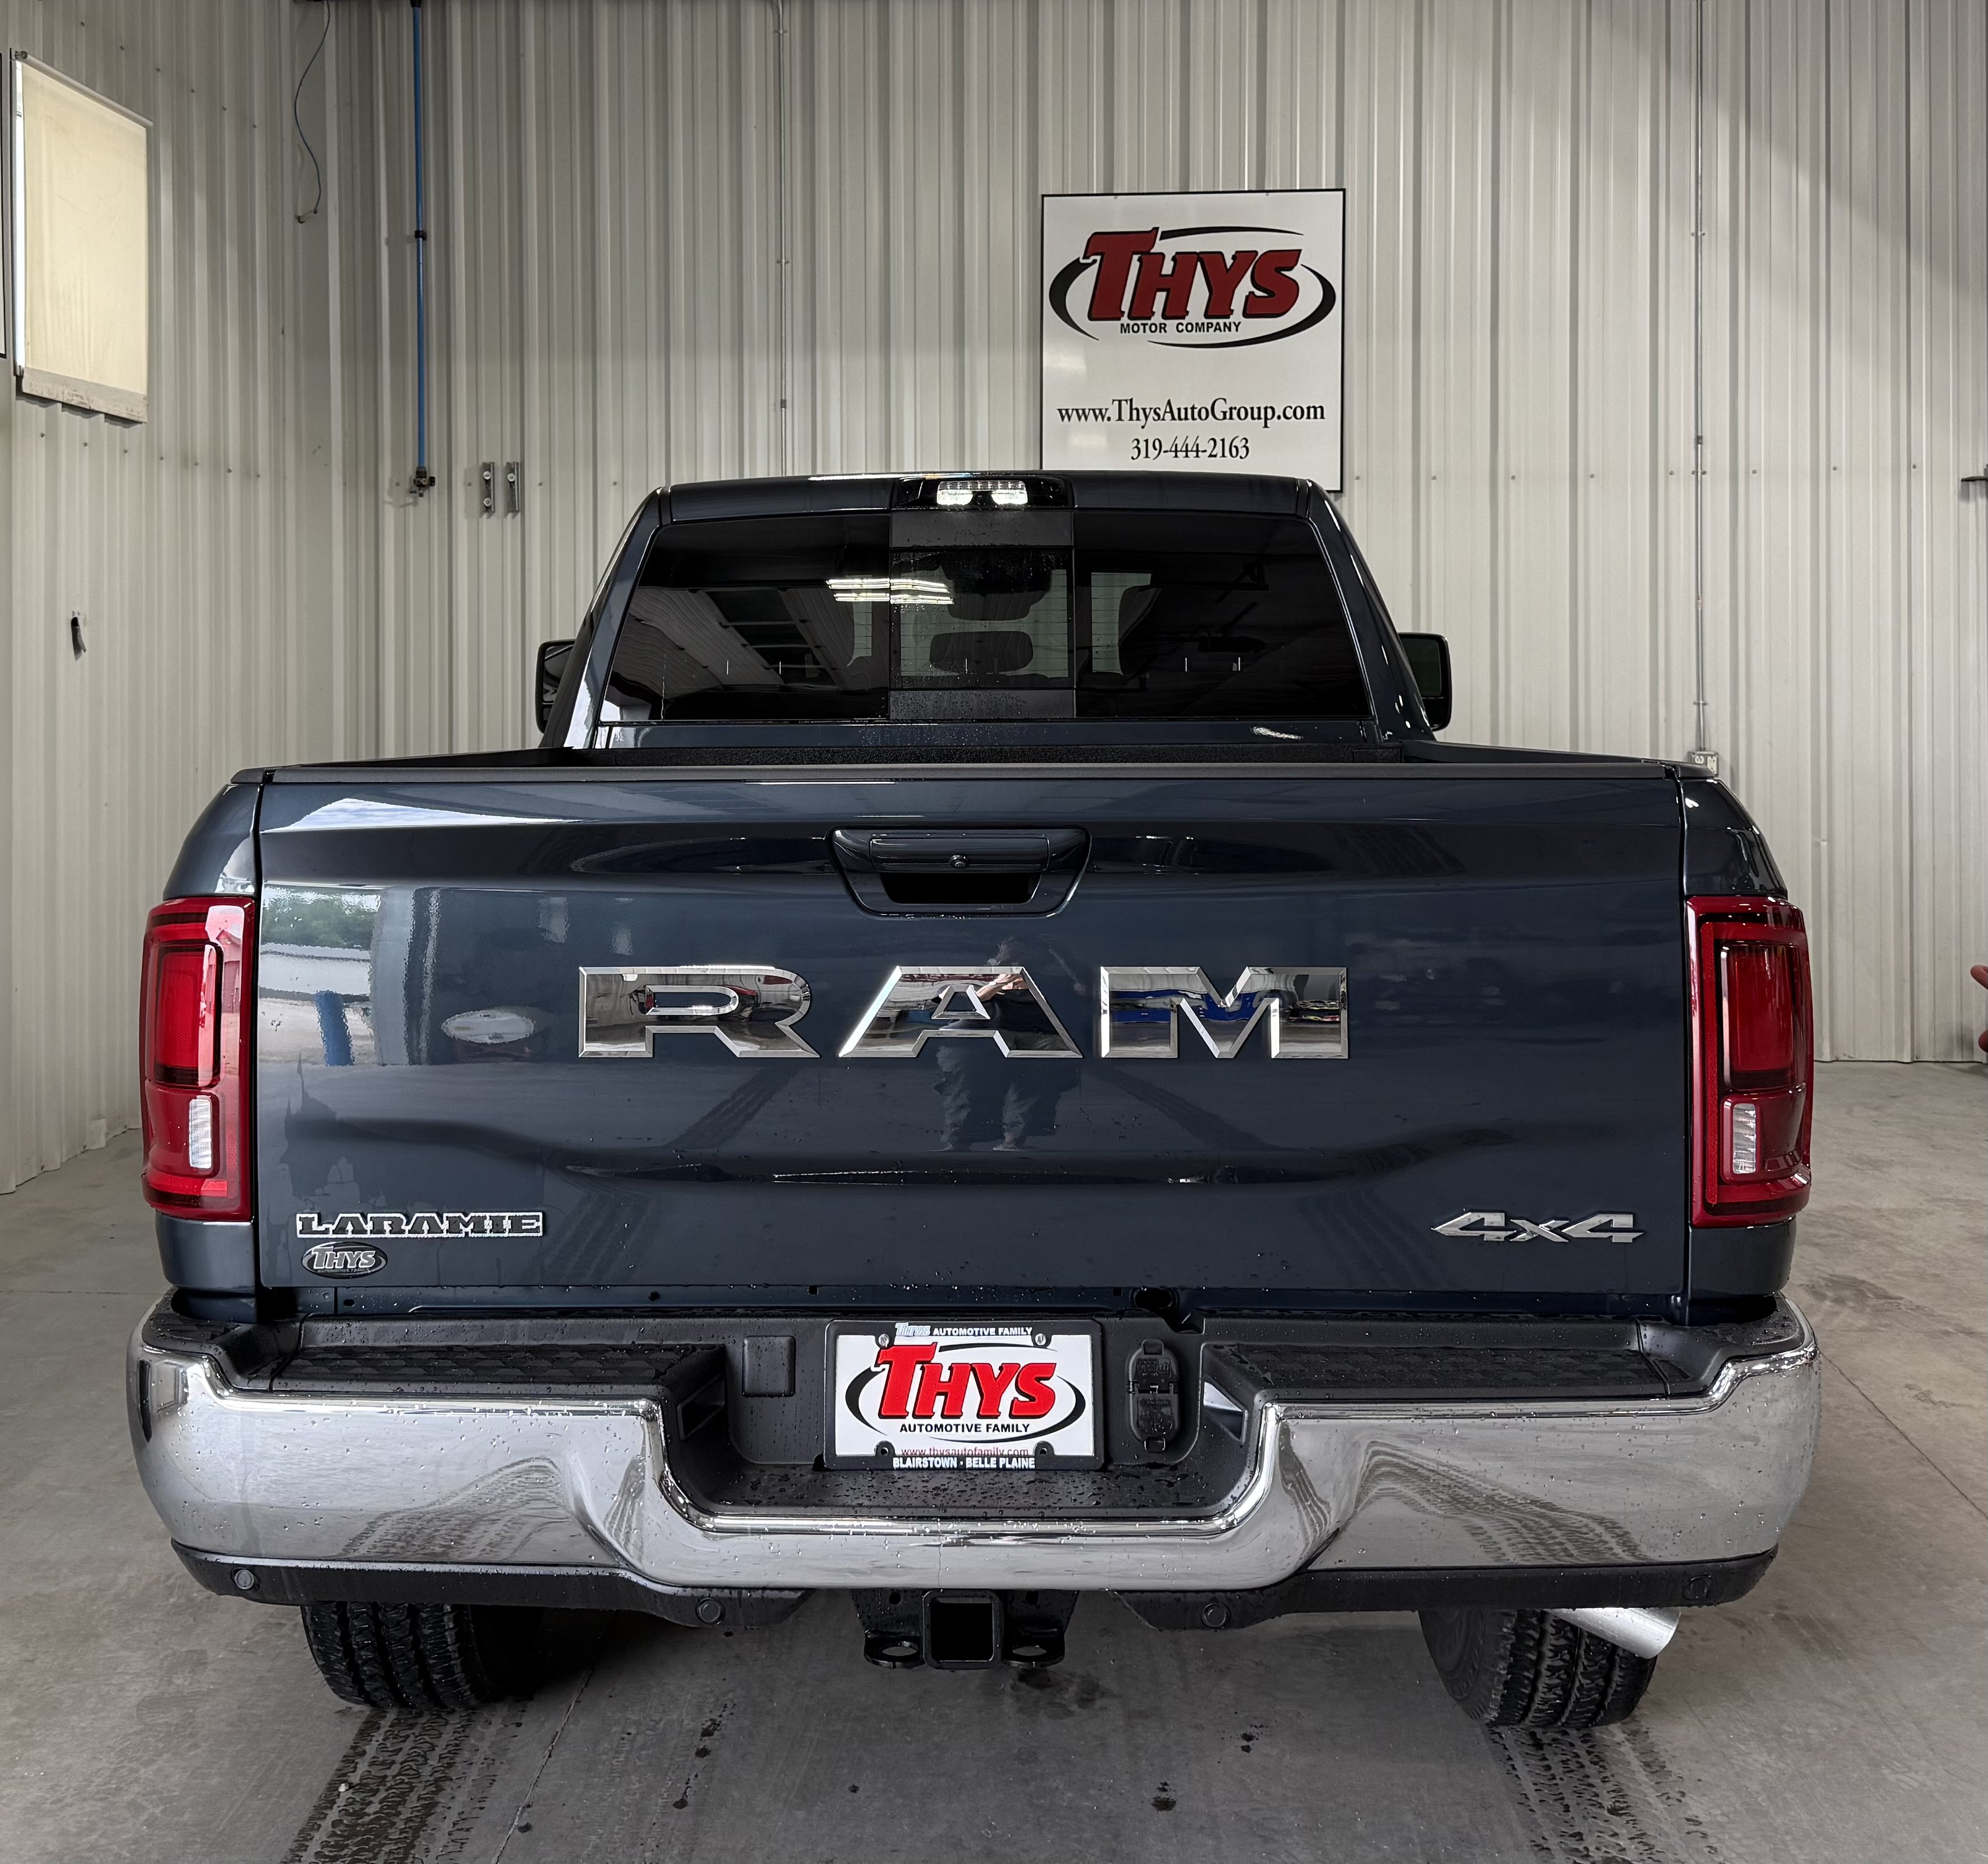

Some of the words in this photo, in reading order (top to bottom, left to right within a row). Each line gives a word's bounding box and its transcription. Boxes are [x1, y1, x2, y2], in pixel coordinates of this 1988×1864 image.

[1083, 226, 1302, 321] THYS
[1120, 322, 1167, 334] MOTOR
[1175, 321, 1241, 333] COMPANY
[1057, 397, 1326, 429] www.ThysAutoGroup.com
[1131, 436, 1250, 460] 319-444-2163
[578, 966, 1349, 1058] RAM
[296, 1212, 543, 1238] LARAMIE
[311, 1246, 376, 1269] THYS
[933, 1327, 995, 1336] AUTOMOTIVE
[998, 1327, 1033, 1336] FAMILY
[875, 1342, 1057, 1419] THYS
[900, 1424, 982, 1433] AUTOMOTIVE
[986, 1424, 1030, 1433] FAMILY
[893, 1457, 958, 1469] BLAIRSTOWN
[966, 1457, 997, 1468] BELLE
[999, 1457, 1036, 1469] PLAINE
